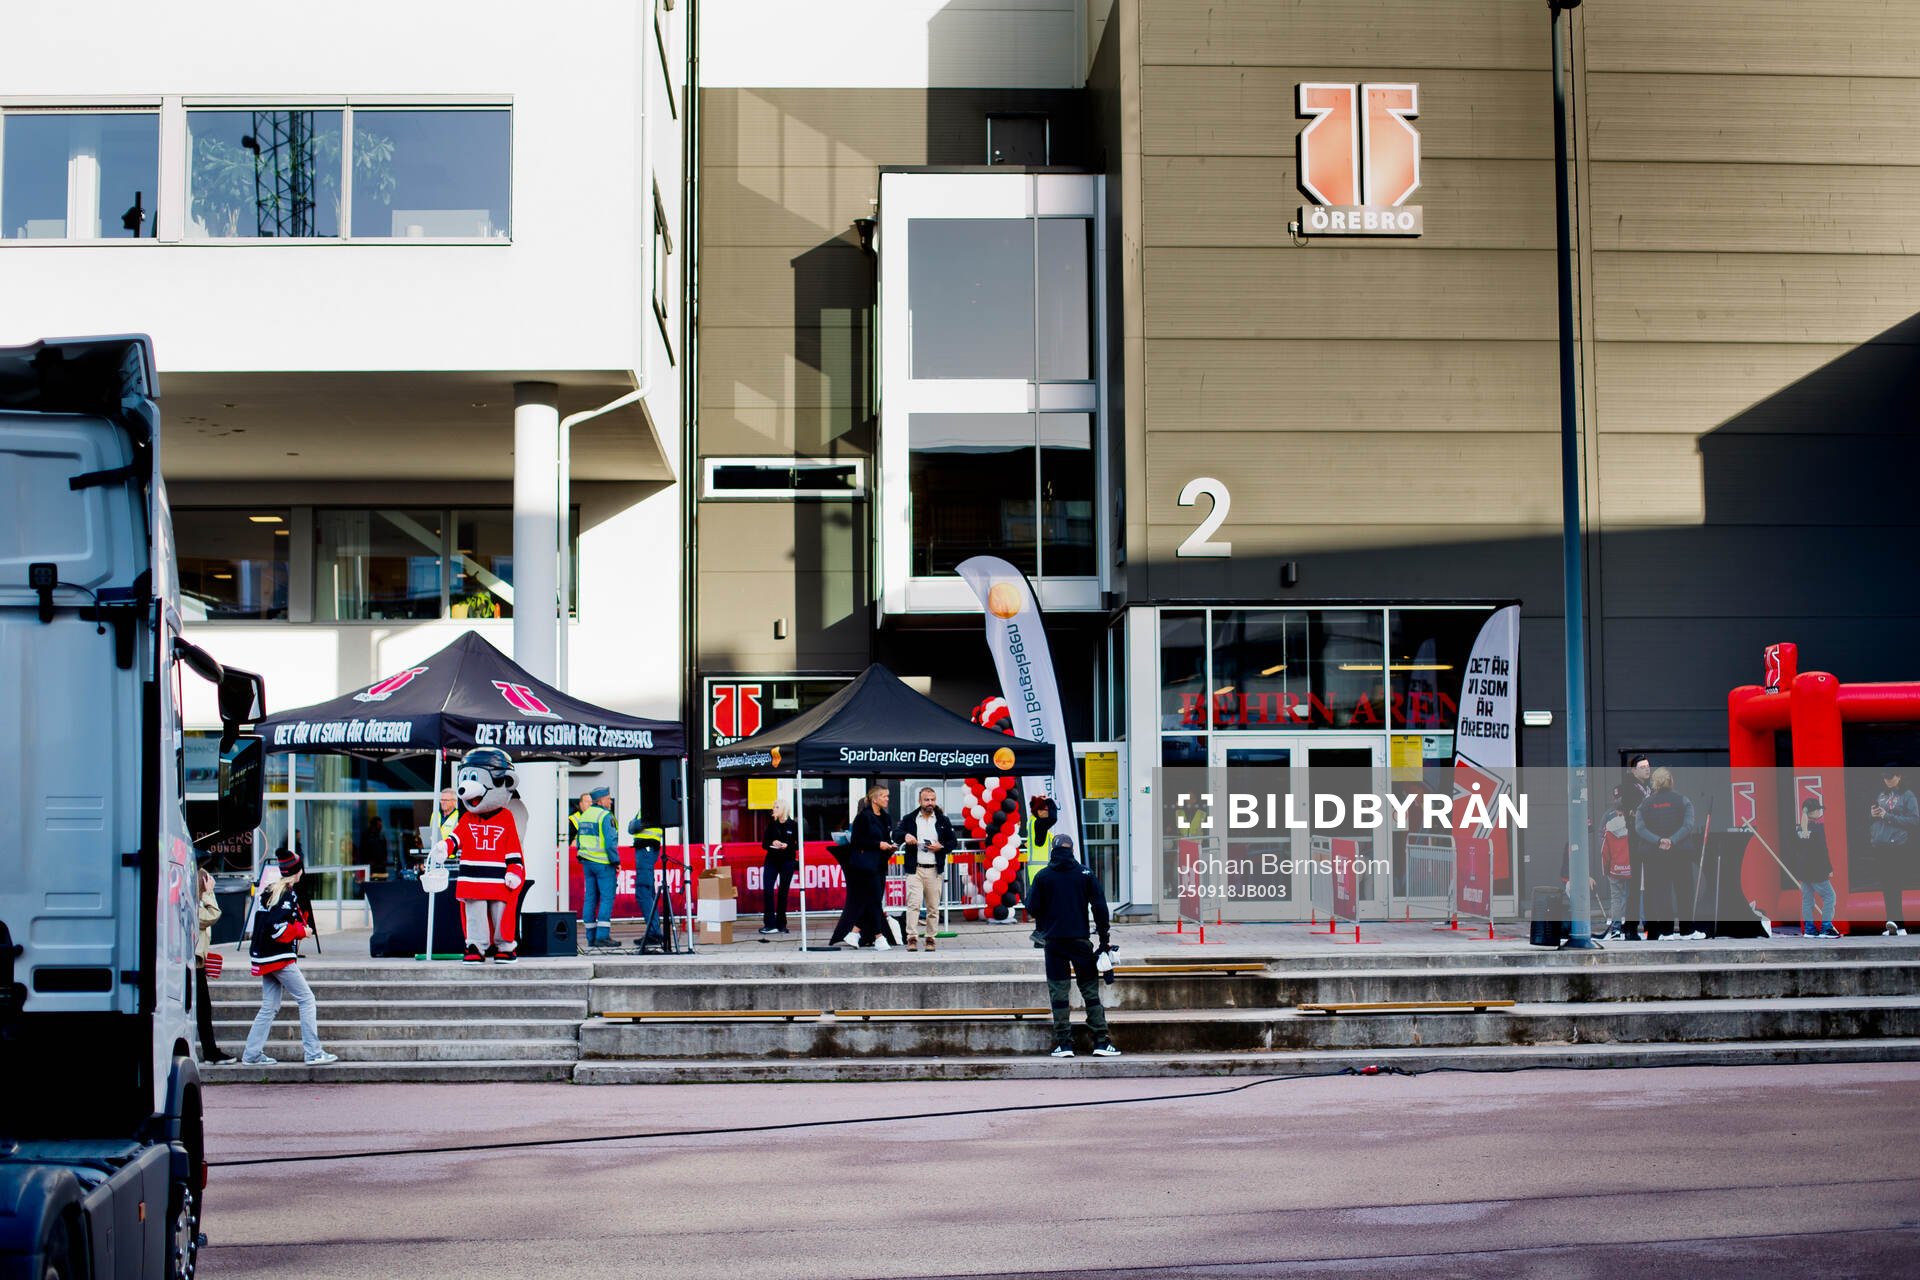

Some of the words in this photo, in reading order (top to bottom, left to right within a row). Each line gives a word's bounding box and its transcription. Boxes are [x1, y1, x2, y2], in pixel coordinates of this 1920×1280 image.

[1311, 206, 1415, 230] ÖREBRO
[1177, 477, 1232, 557] 2
[1469, 657, 1490, 674] DET
[1491, 655, 1509, 676] ÄR
[1468, 678, 1479, 695] VI
[1480, 679, 1508, 697] SOM
[1179, 692, 1335, 725] BEHRN
[1348, 690, 1458, 723] AREN
[1476, 697, 1494, 717] ÄR
[274, 724, 296, 745] DET
[293, 720, 311, 744] ÄR
[309, 722, 323, 744] VI
[320, 721, 348, 743] SOM
[346, 718, 364, 743] ÄR
[363, 718, 412, 743] ÖREBRO
[475, 723, 504, 745] DET
[505, 720, 525, 746] ÄR
[527, 724, 543, 746] VI
[544, 723, 577, 746] SOM
[578, 723, 599, 747] ÄR
[599, 725, 654, 749] ÖREBRO
[1460, 717, 1510, 739] ÖREBRO
[839, 746, 916, 764] Sparbanken
[918, 748, 989, 767] Bergslagen
